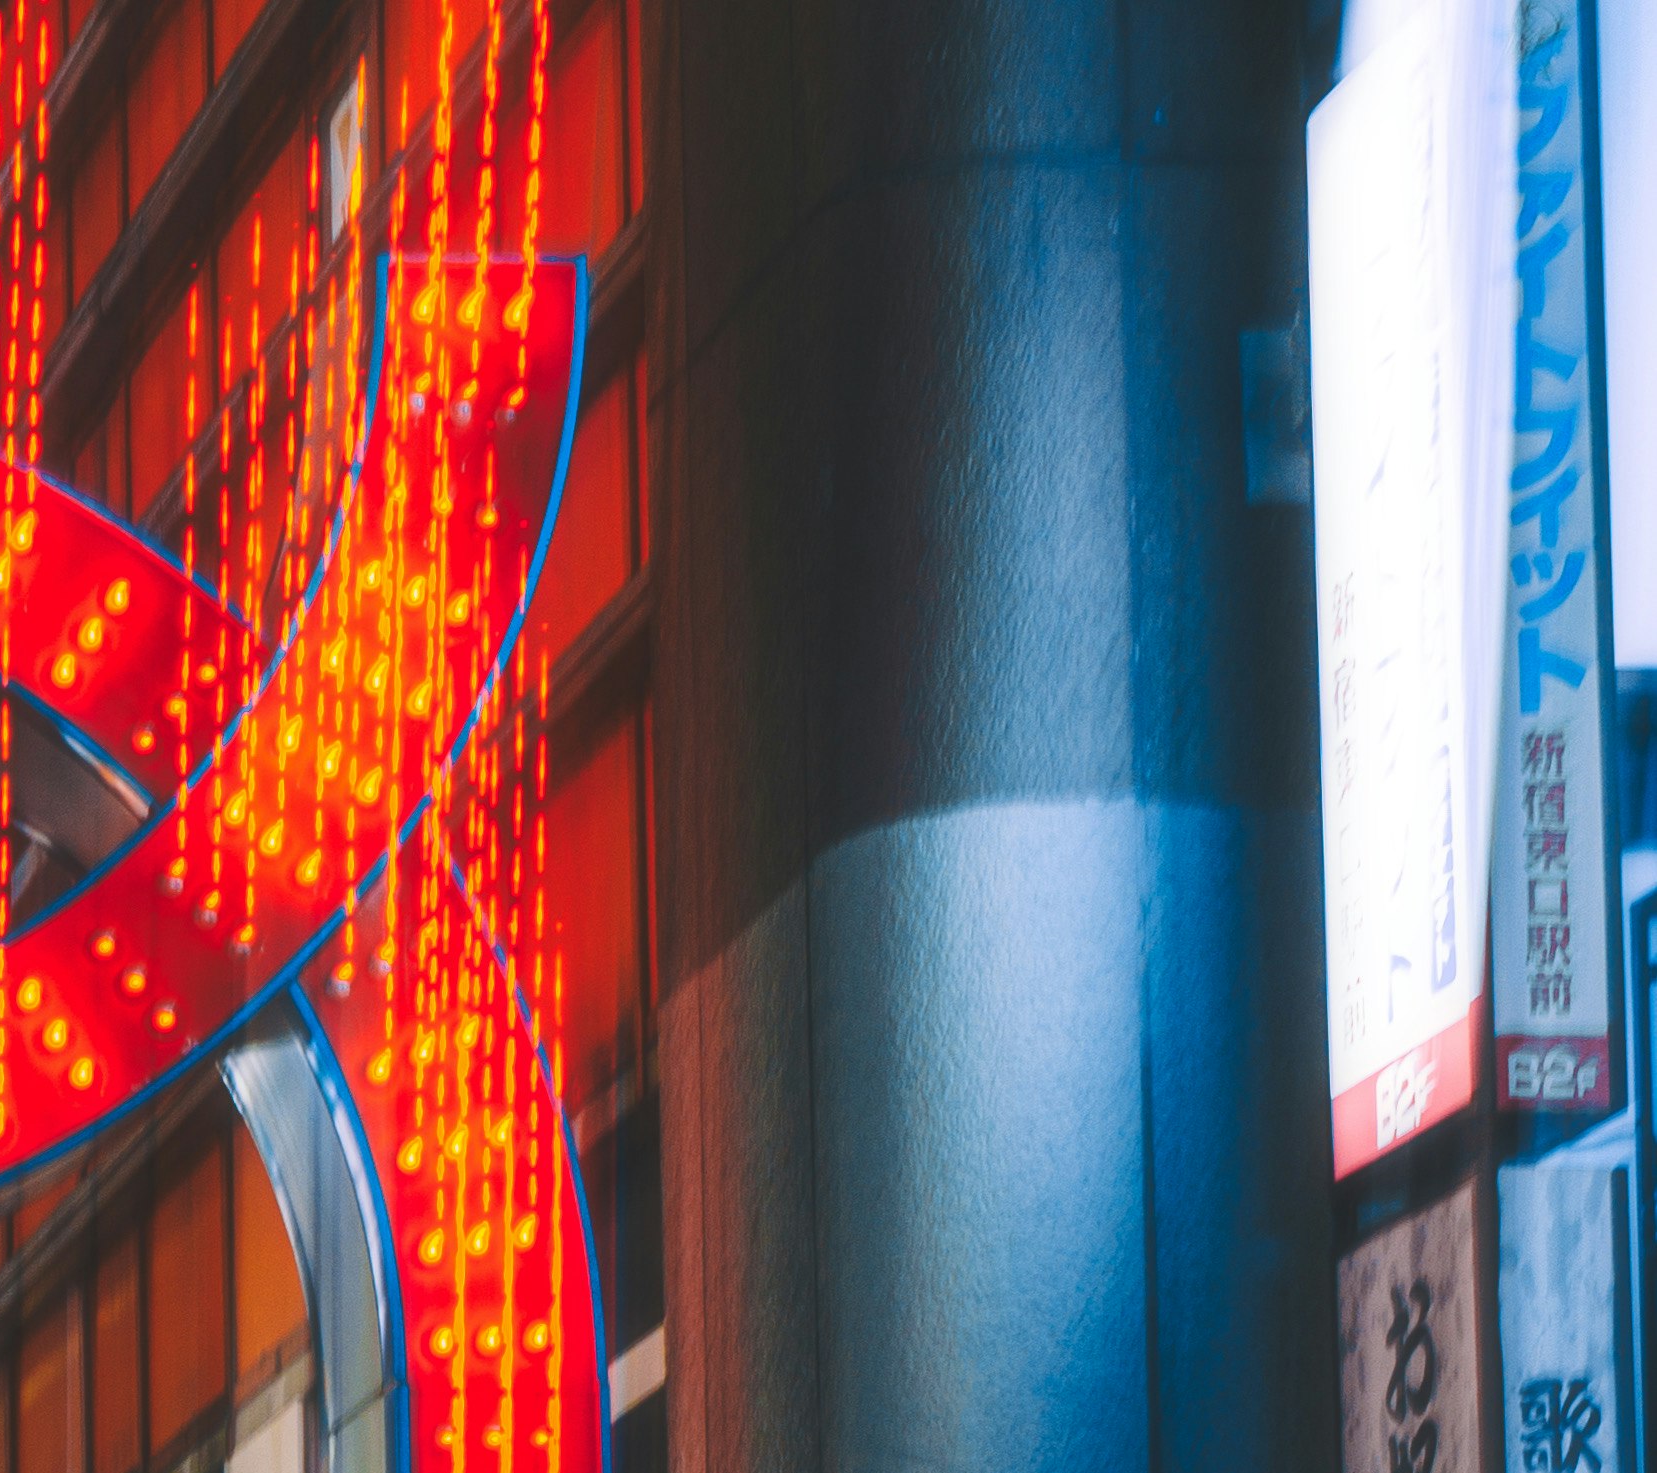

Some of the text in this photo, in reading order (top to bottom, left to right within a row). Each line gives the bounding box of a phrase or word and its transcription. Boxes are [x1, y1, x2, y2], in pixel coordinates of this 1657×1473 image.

[1522, 726, 1571, 1017] 新宿東口駅前
[1376, 1059, 1436, 1152] B2F
[1508, 1045, 1597, 1101] B2F
